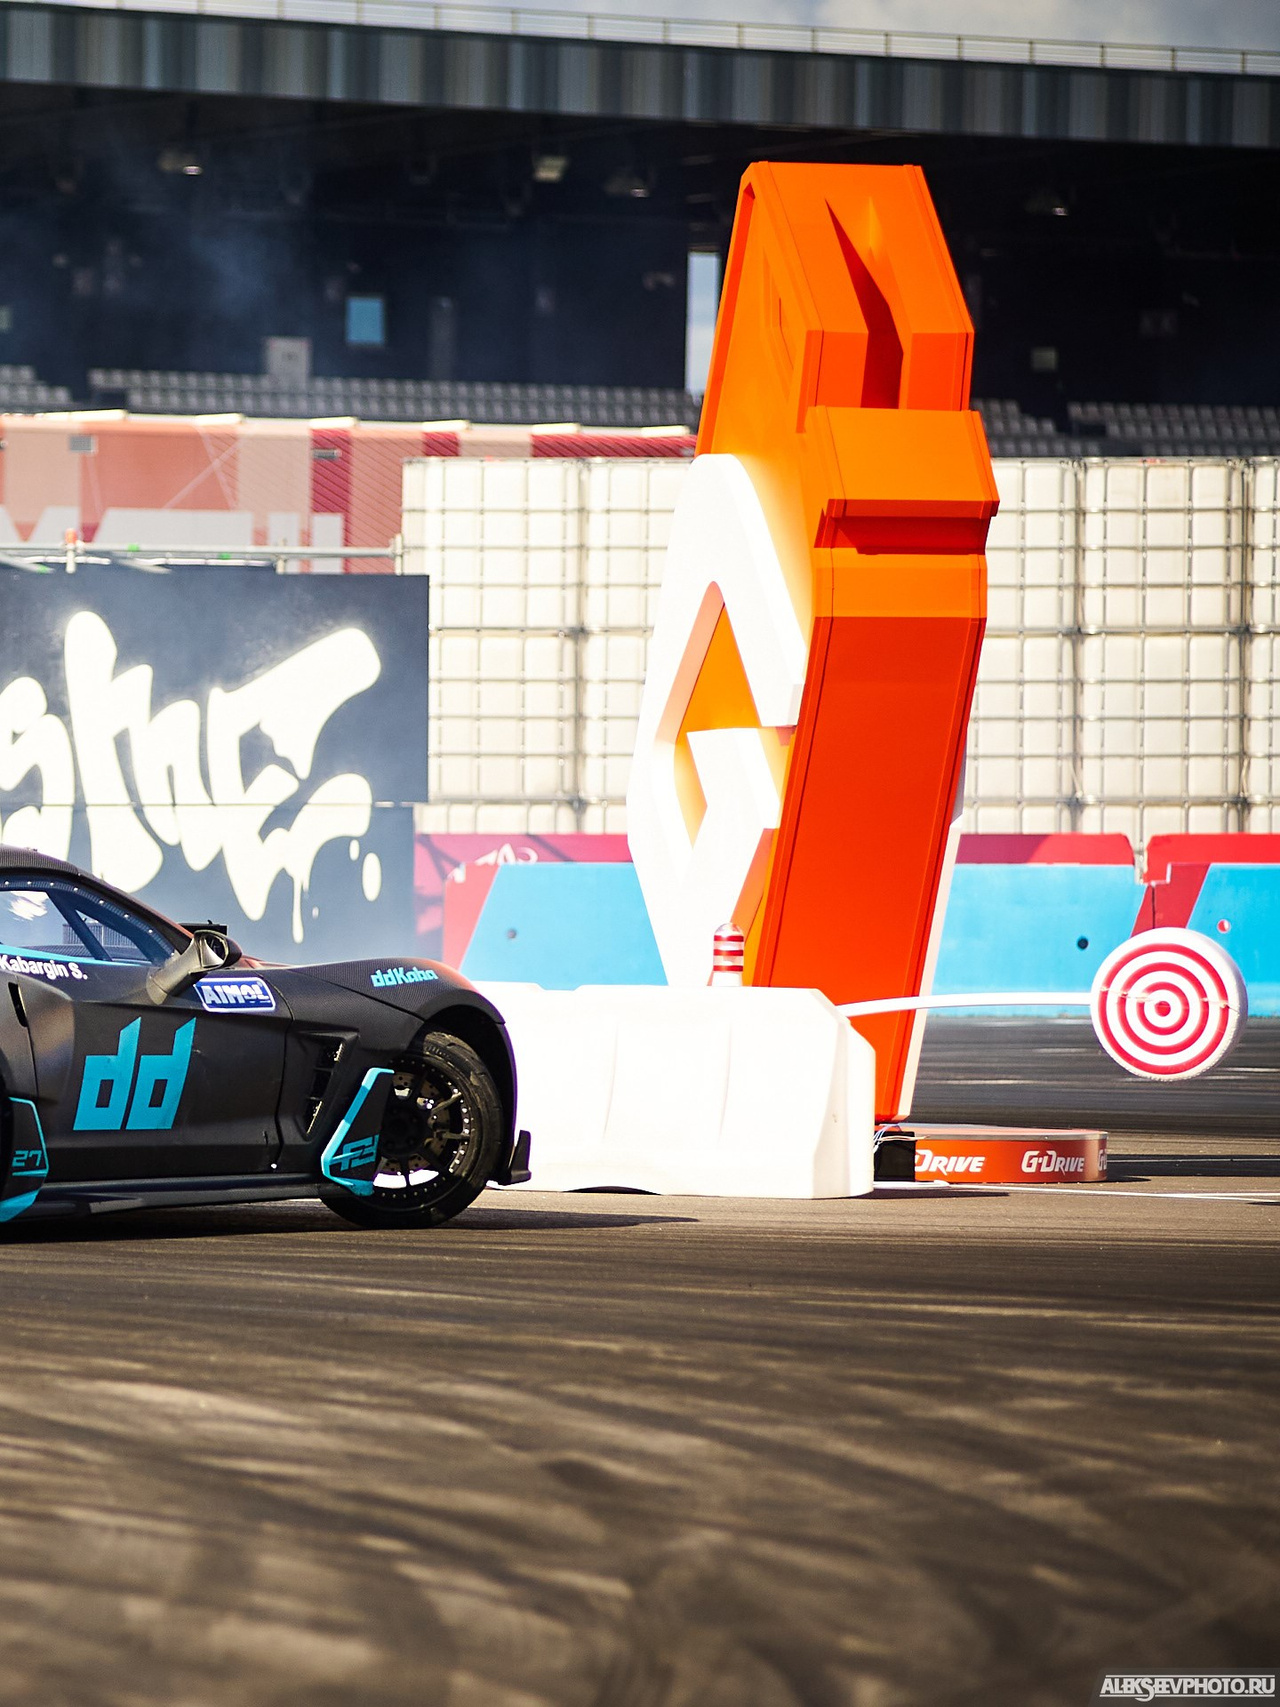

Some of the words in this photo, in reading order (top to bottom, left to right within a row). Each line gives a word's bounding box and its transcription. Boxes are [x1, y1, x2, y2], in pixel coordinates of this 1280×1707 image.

[70, 962, 88, 980] S.
[73, 1017, 196, 1130] dd
[12, 1150, 42, 1167] 27
[915, 1149, 985, 1175] DRIVE
